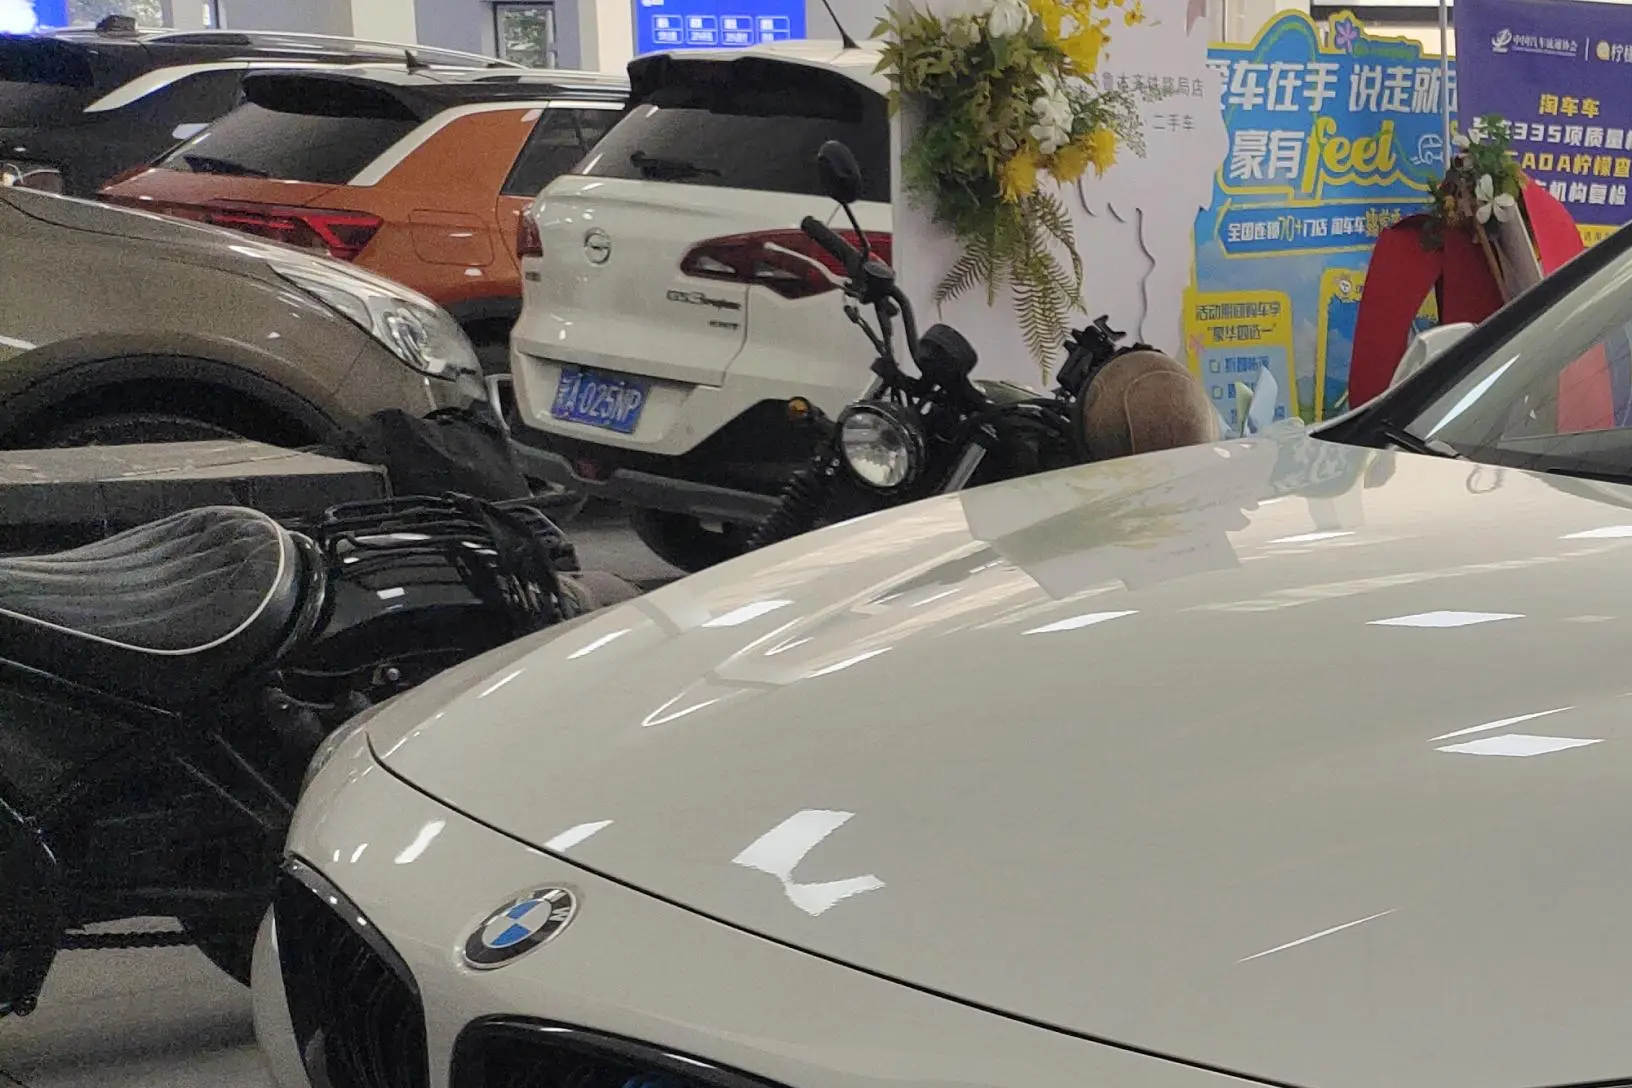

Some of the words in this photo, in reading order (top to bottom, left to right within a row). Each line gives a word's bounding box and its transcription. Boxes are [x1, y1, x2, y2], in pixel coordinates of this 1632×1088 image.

[1539, 94, 1600, 118] 淘车车
[1229, 129, 1305, 180] 豪有
[1300, 116, 1397, 194] feel
[1503, 150, 1632, 178] ADA柠檬查
[1535, 180, 1627, 205] 机构复检
